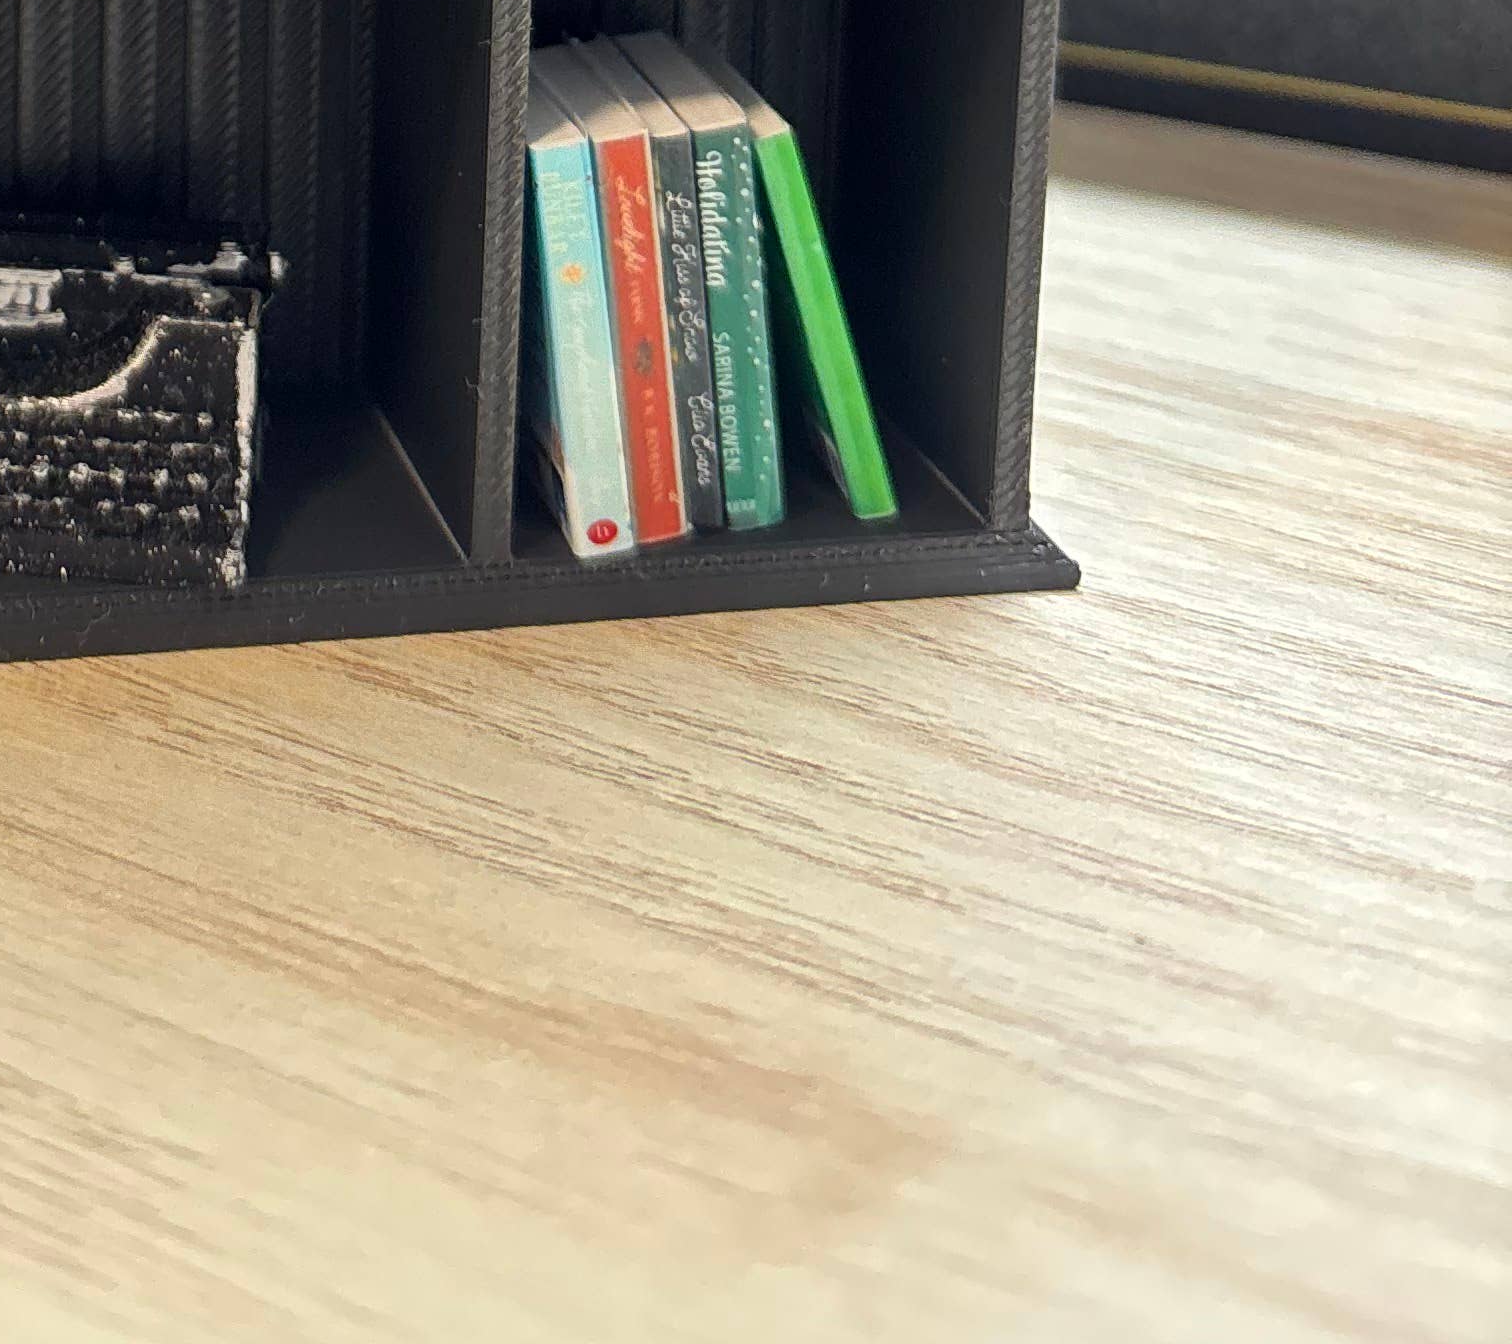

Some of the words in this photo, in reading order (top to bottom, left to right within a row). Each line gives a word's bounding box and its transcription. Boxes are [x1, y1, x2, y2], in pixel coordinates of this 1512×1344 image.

[697, 151, 730, 286] Holidating
[713, 333, 732, 395] SARINA
[719, 406, 740, 469] BOWEN
